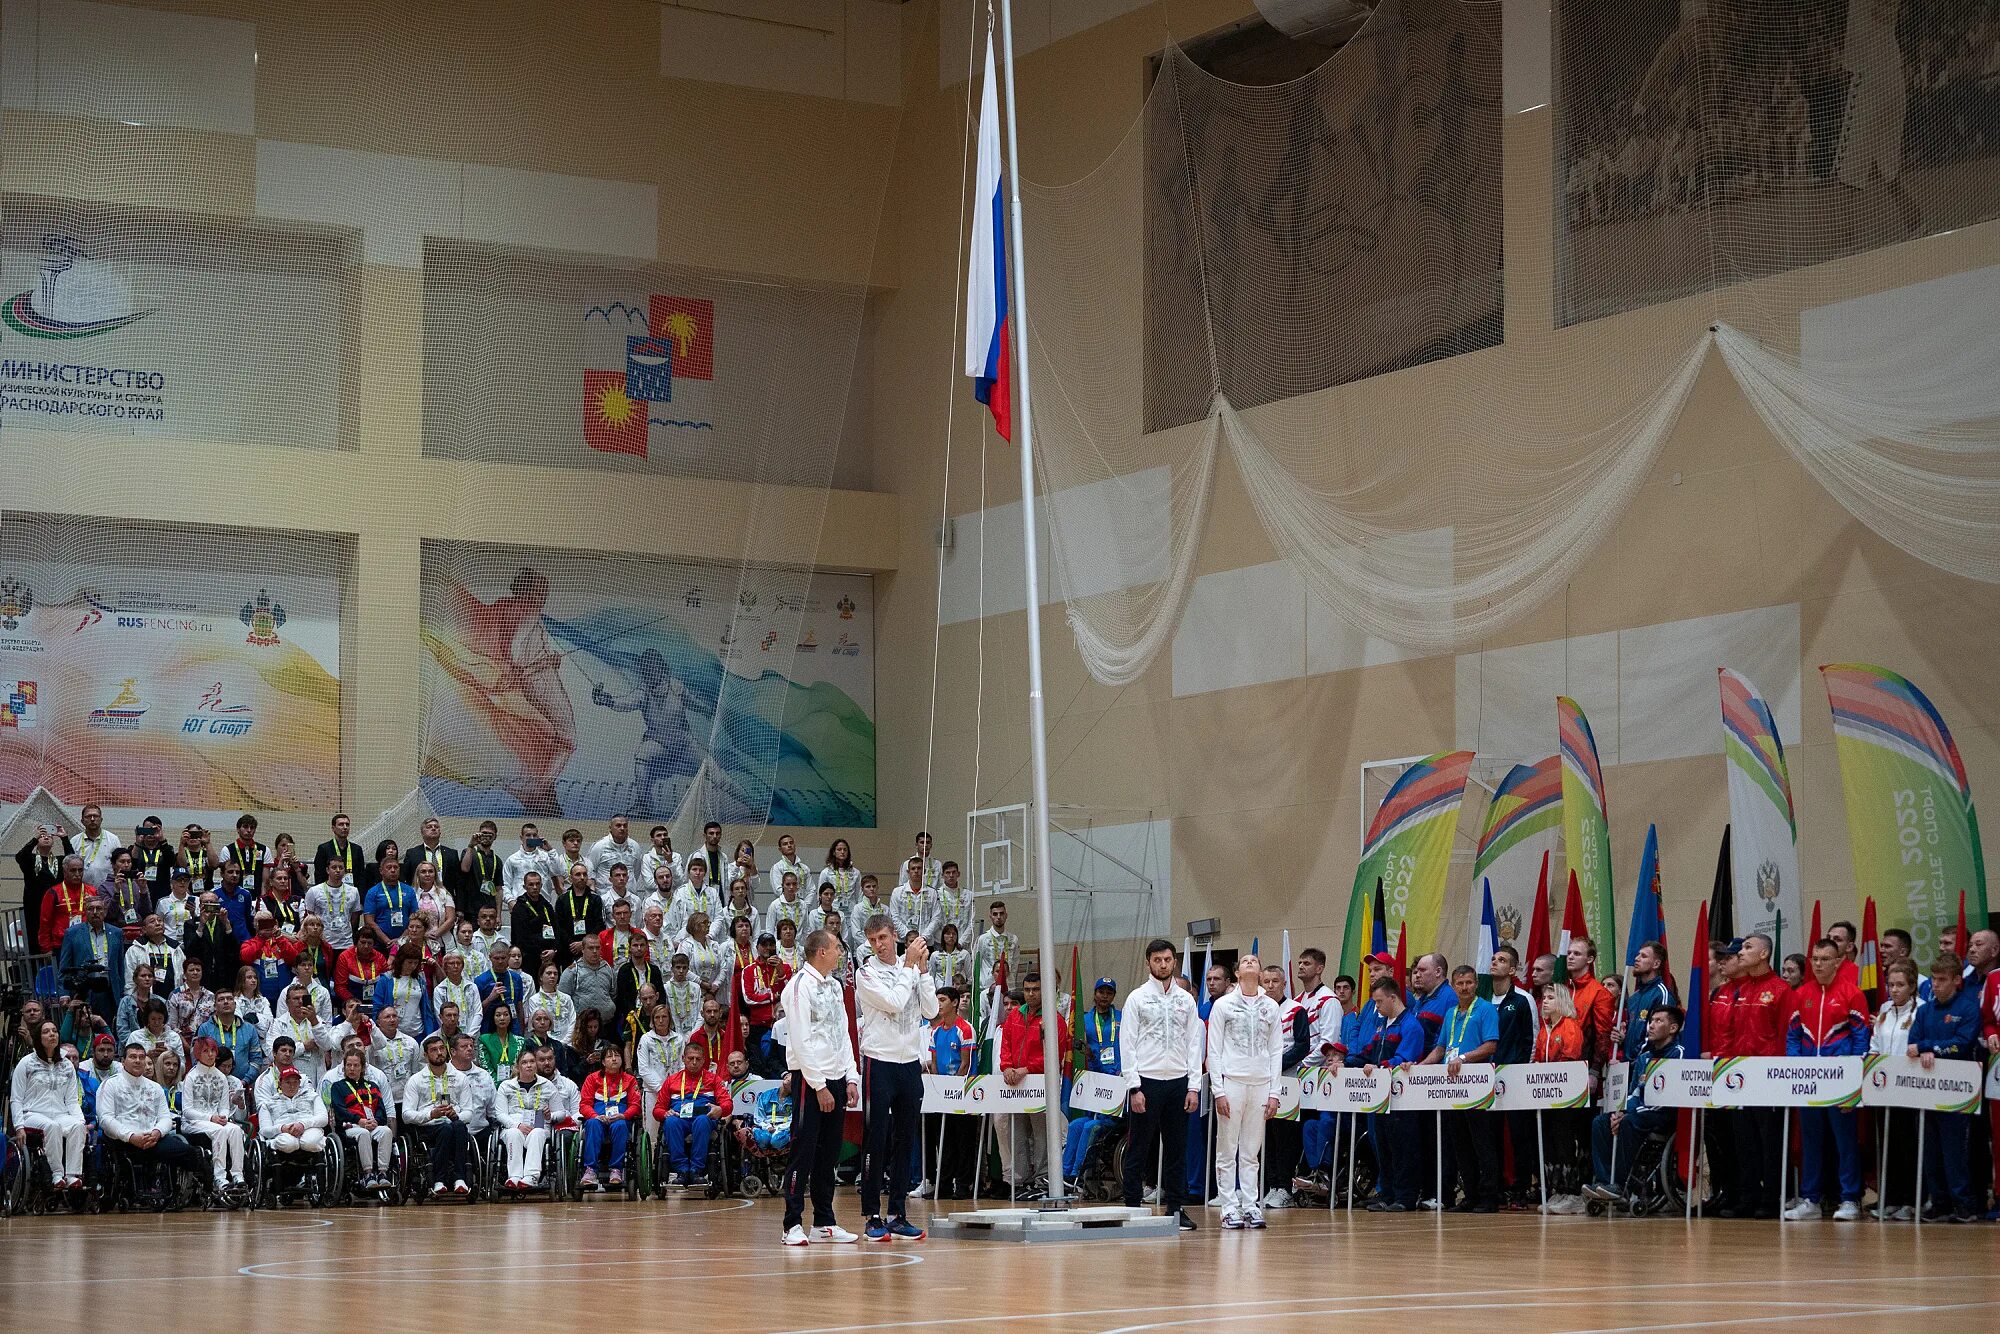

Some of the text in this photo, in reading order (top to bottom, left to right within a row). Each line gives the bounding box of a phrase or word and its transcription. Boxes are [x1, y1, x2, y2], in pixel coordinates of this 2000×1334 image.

[0, 383, 163, 404] ИЗИЧЕСКОЙ КУЛЬТУРЫ И СПОРТА
[0, 396, 164, 421] РАСНОДАРСКОГО КРАЯ
[181, 718, 208, 733] ЮГ
[1391, 854, 1416, 917] 2022
[1681, 1070, 1712, 1081] КОСТРОМ
[1767, 1066, 1844, 1079] КРАСНОЯРСКИЙ
[1345, 1077, 1377, 1089] ИВАНОВСКАЯ
[1408, 1075, 1489, 1086] КАБАРДИНО-БАЛКАРСКАЯ
[1526, 1073, 1568, 1084] КАЛУЖСКАЯ
[1895, 1075, 1974, 1093] ЛИПЕЦКАЯ ОБЛАСТЬ
[1000, 1089, 1045, 1099] ТАДЖИКИСТАН
[1427, 1089, 1469, 1099] РЕСПУБЛИКА
[1532, 1088, 1563, 1099] ОБЛАСТЬ
[1792, 1082, 1817, 1095] КРАЙ
[944, 1089, 962, 1100] МАЛИ
[1348, 1092, 1371, 1103] ОБЛАСТЬ
